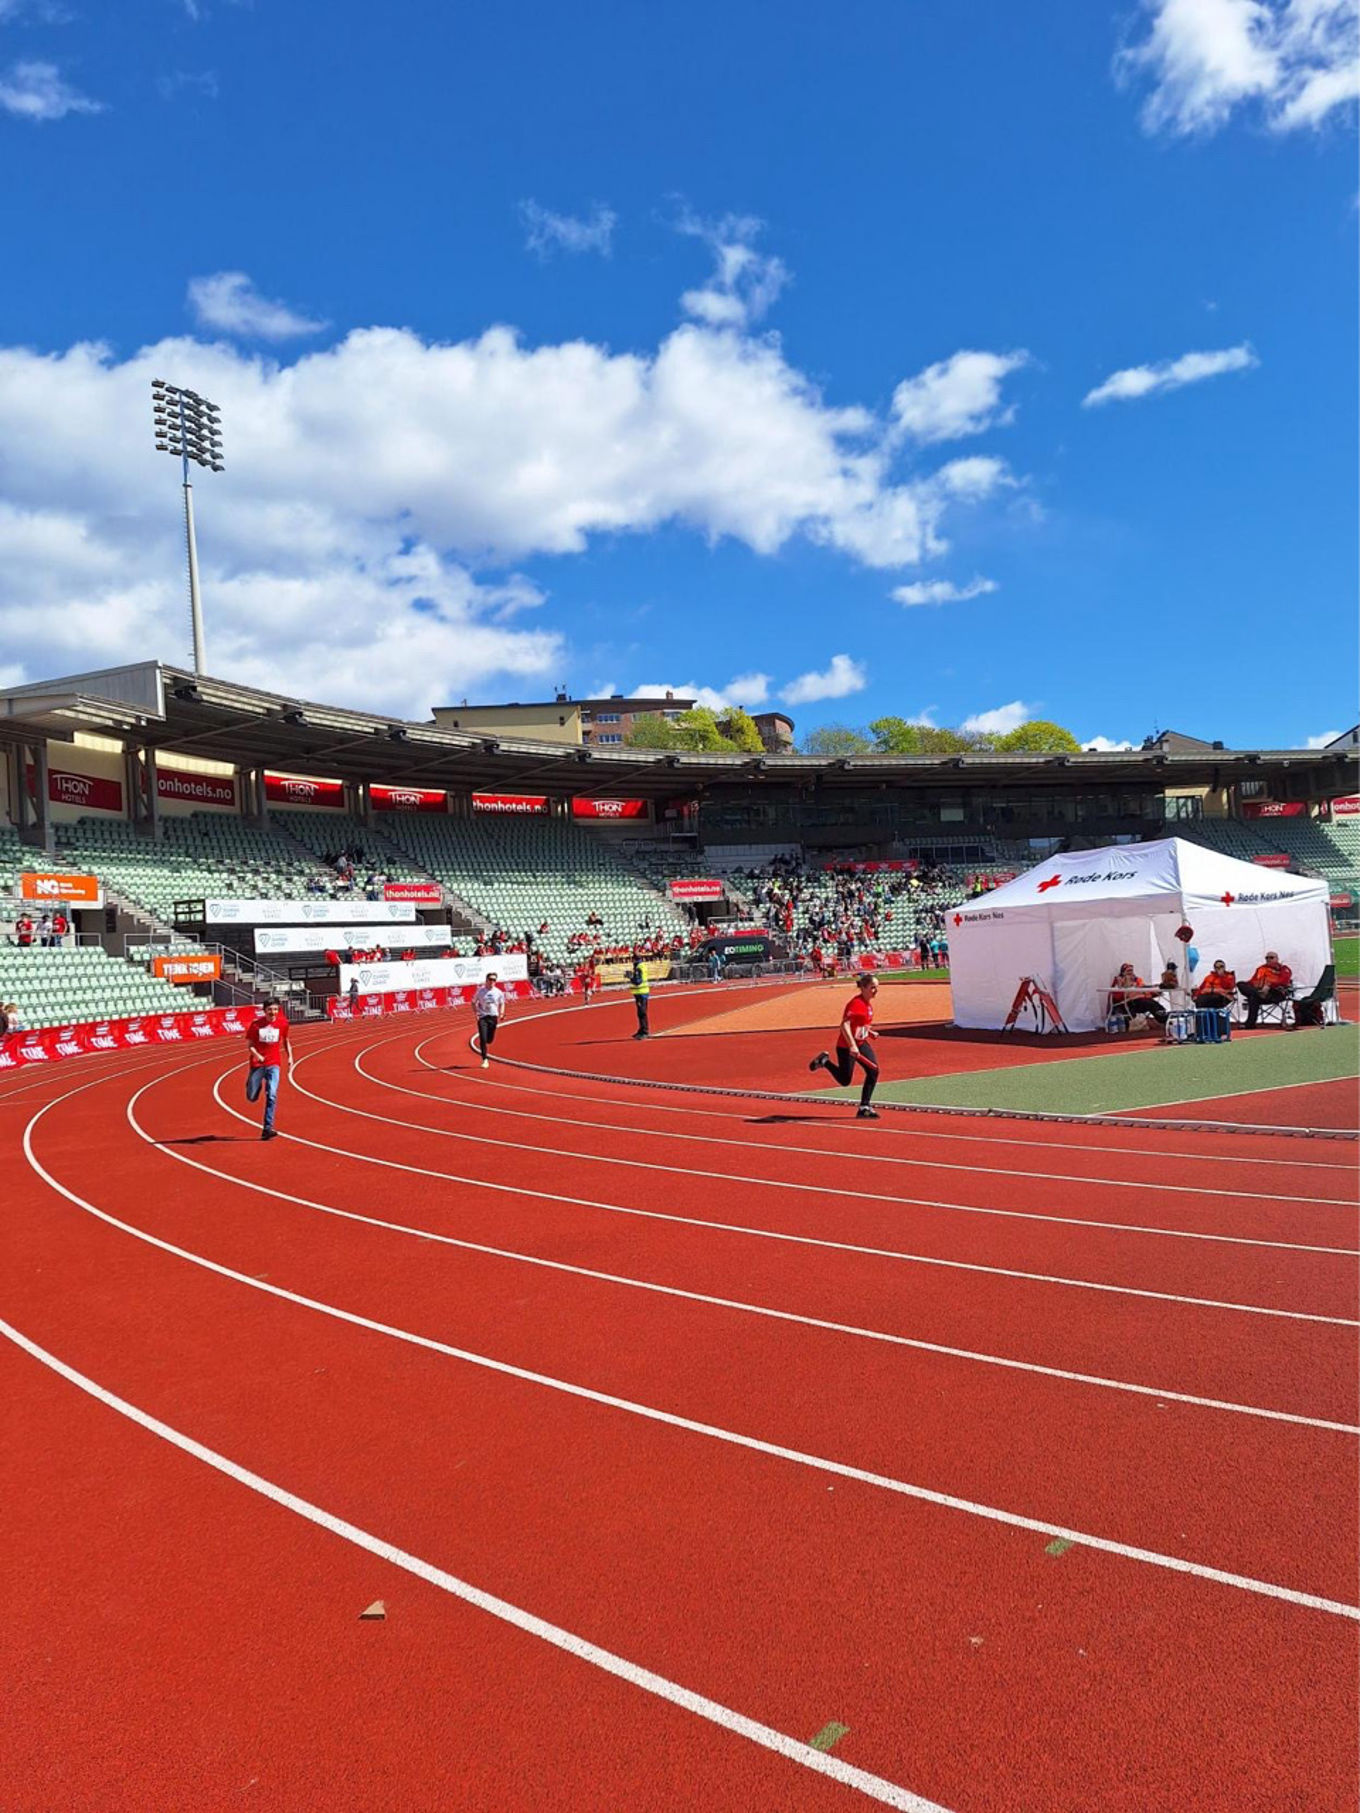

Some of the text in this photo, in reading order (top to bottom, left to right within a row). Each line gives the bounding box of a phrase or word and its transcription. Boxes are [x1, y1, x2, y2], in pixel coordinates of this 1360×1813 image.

[52, 774, 94, 795] THON
[158, 778, 232, 799] onhotels.no
[280, 780, 319, 796] THON
[62, 793, 86, 804] HOTELS
[388, 791, 424, 805] THON
[472, 799, 548, 814] thonhotels.no
[592, 800, 626, 812] THON
[1102, 870, 1139, 882] Kors
